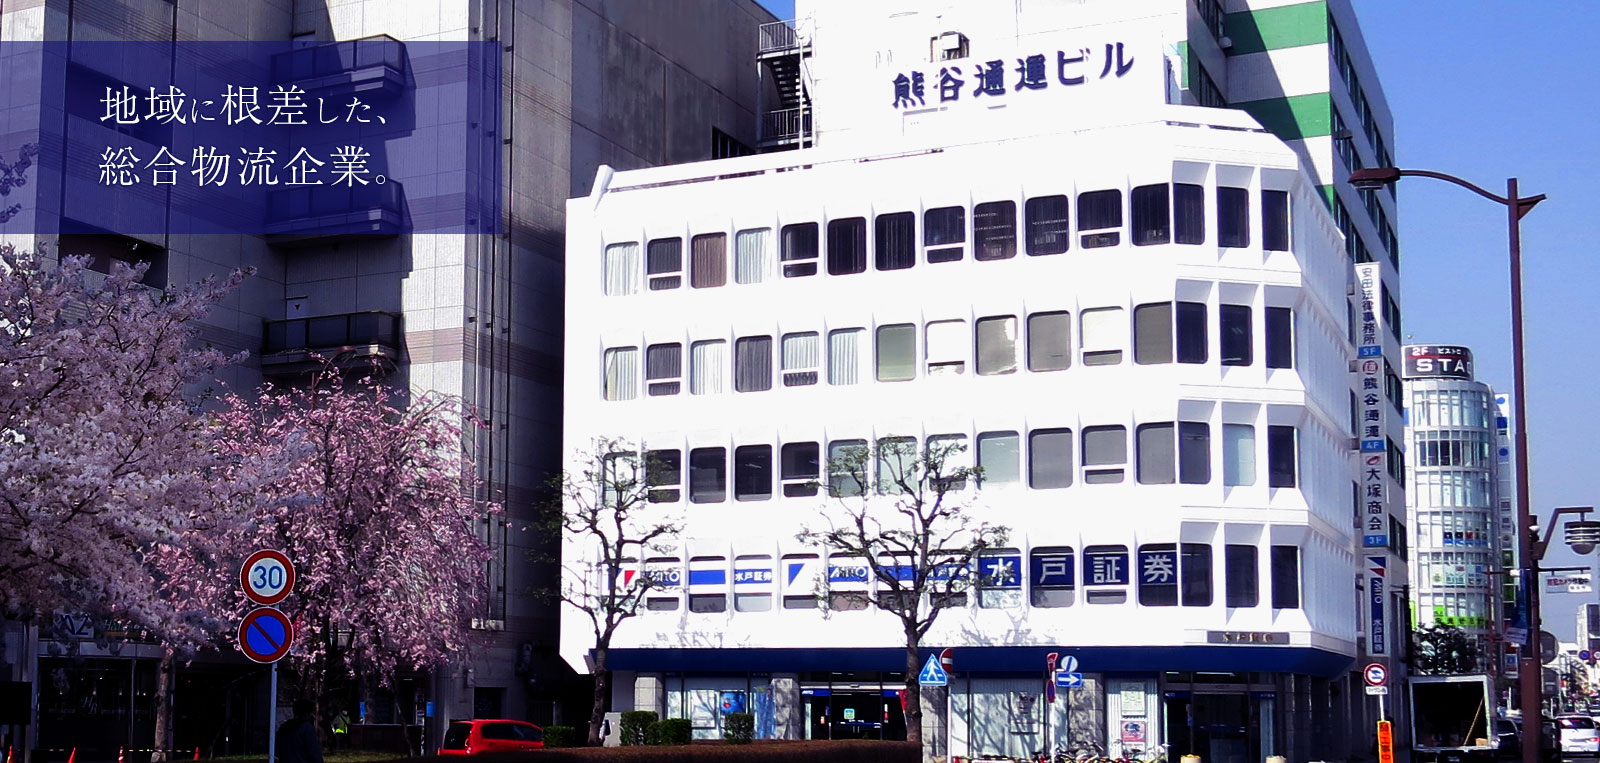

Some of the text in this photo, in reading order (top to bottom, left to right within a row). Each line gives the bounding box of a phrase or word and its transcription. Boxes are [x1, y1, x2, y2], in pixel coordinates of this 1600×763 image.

[892, 42, 1134, 109] 熊谷通運ビル
[1361, 267, 1376, 345] 安田法律事務所
[1412, 346, 1429, 356] 2F
[1363, 377, 1379, 437] 熊谷通運
[1366, 468, 1382, 530] 大塚商会
[253, 565, 283, 589] 30
[986, 554, 1173, 586] 水戸証券
